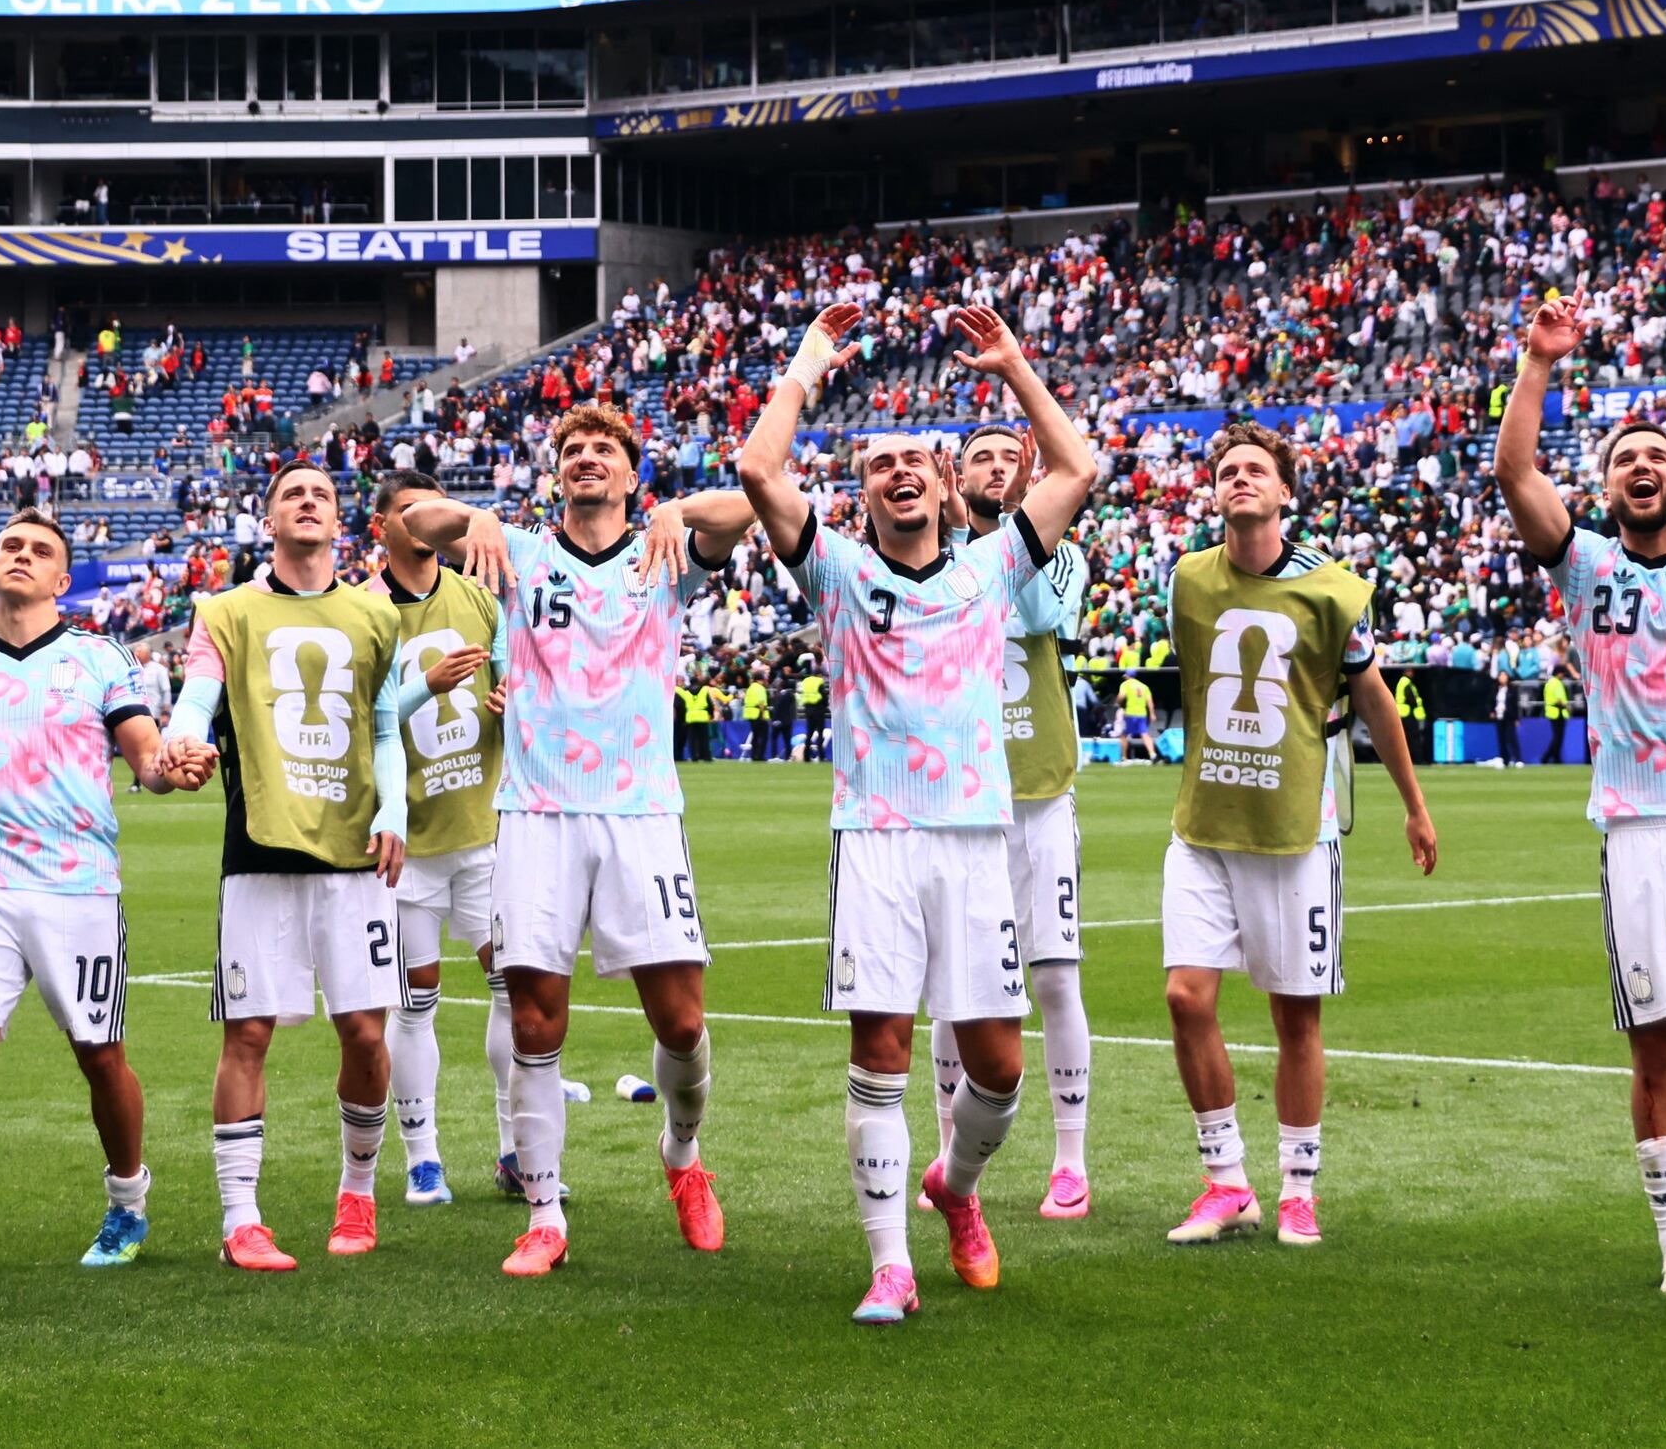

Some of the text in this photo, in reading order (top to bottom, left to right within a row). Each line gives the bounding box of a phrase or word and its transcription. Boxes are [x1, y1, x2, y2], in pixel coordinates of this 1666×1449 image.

[286, 230, 543, 261] SEATTLE
[533, 587, 573, 628] 15
[870, 589, 897, 634] 3
[1593, 585, 1642, 636] 23
[1004, 707, 1032, 719] CUP
[1227, 718, 1261, 734] FIFA
[299, 731, 331, 747] FIFA
[437, 725, 466, 745] FIFA
[422, 753, 482, 777] WORLD CUP
[1203, 747, 1282, 766] WORLD CUP
[286, 772, 346, 802] 2026
[425, 766, 483, 798] 2026
[1200, 762, 1279, 789] 2026
[654, 873, 694, 919] 15
[1058, 876, 1074, 920] 2
[367, 920, 394, 968] 2
[1309, 906, 1327, 952] 5
[1001, 921, 1019, 970] 3
[76, 956, 113, 1004] 10
[520, 1171, 554, 1183] BFA
[856, 1158, 900, 1169] RBFA
